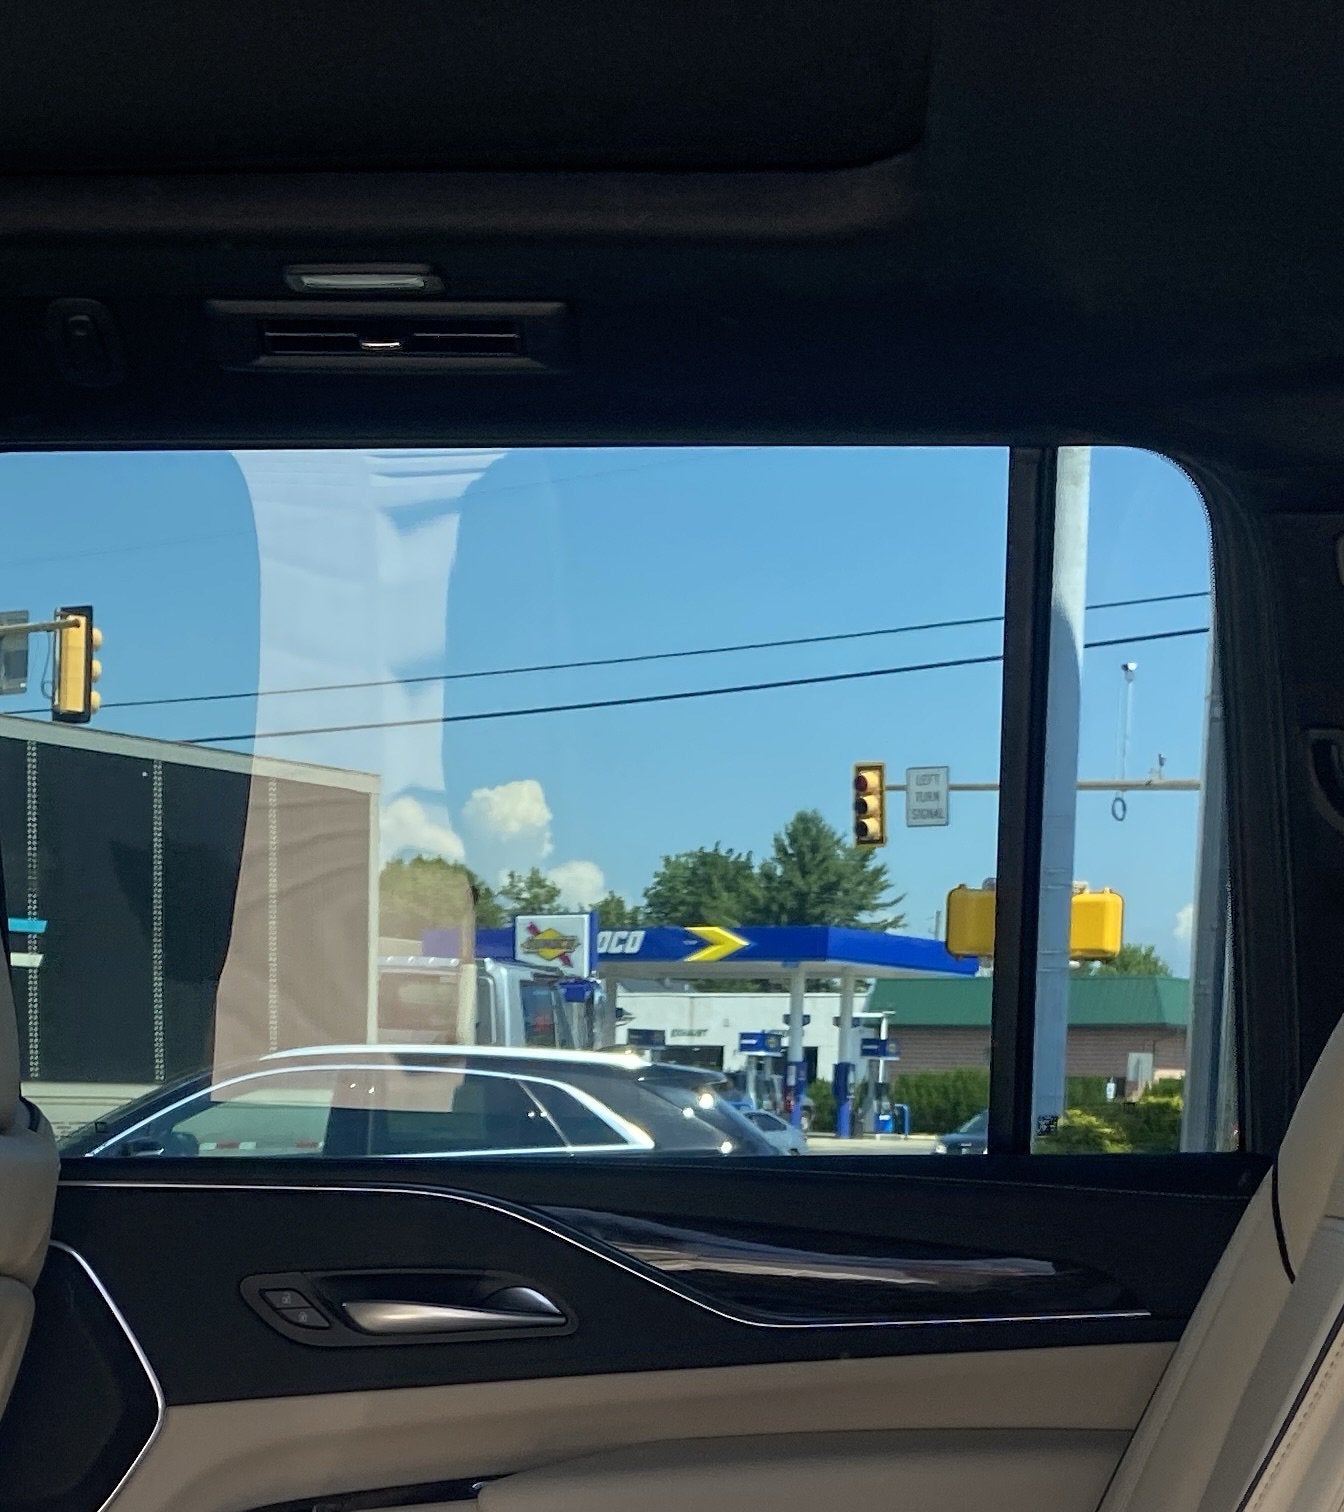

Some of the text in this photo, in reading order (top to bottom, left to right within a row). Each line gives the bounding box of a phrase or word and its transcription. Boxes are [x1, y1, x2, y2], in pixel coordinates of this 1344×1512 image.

[916, 773, 940, 785] LEFT
[915, 791, 940, 802] TURN
[911, 808, 945, 819] SIGNAL
[597, 930, 646, 954] OCO
